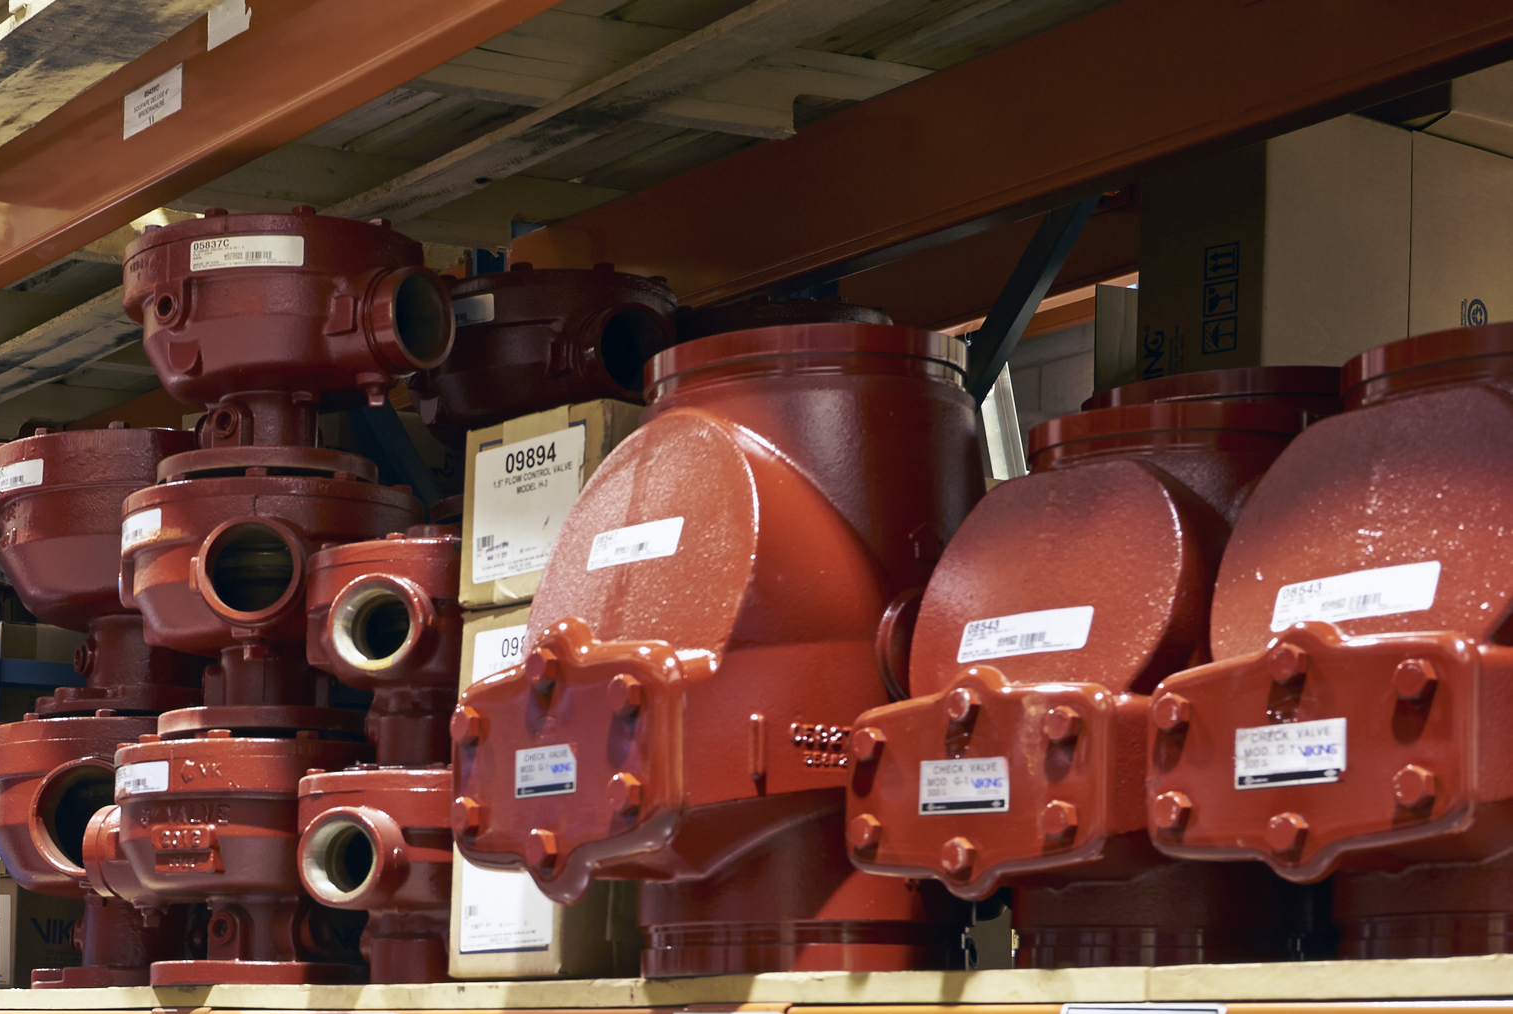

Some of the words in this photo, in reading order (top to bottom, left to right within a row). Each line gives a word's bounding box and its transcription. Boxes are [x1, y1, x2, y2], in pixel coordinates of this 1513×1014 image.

[193, 239, 229, 250] 05837C
[506, 442, 556, 473] 09894
[505, 473, 522, 486] FLOW
[524, 467, 551, 482] CONTROL
[553, 461, 572, 473] VALVE
[516, 483, 537, 494] MODEL
[1283, 582, 1322, 599] 08543
[968, 620, 999, 634] 08543
[1251, 731, 1288, 743] CHECK
[1298, 726, 1330, 738] VALVE
[933, 765, 964, 774] CHECK
[970, 762, 997, 771] VALVE
